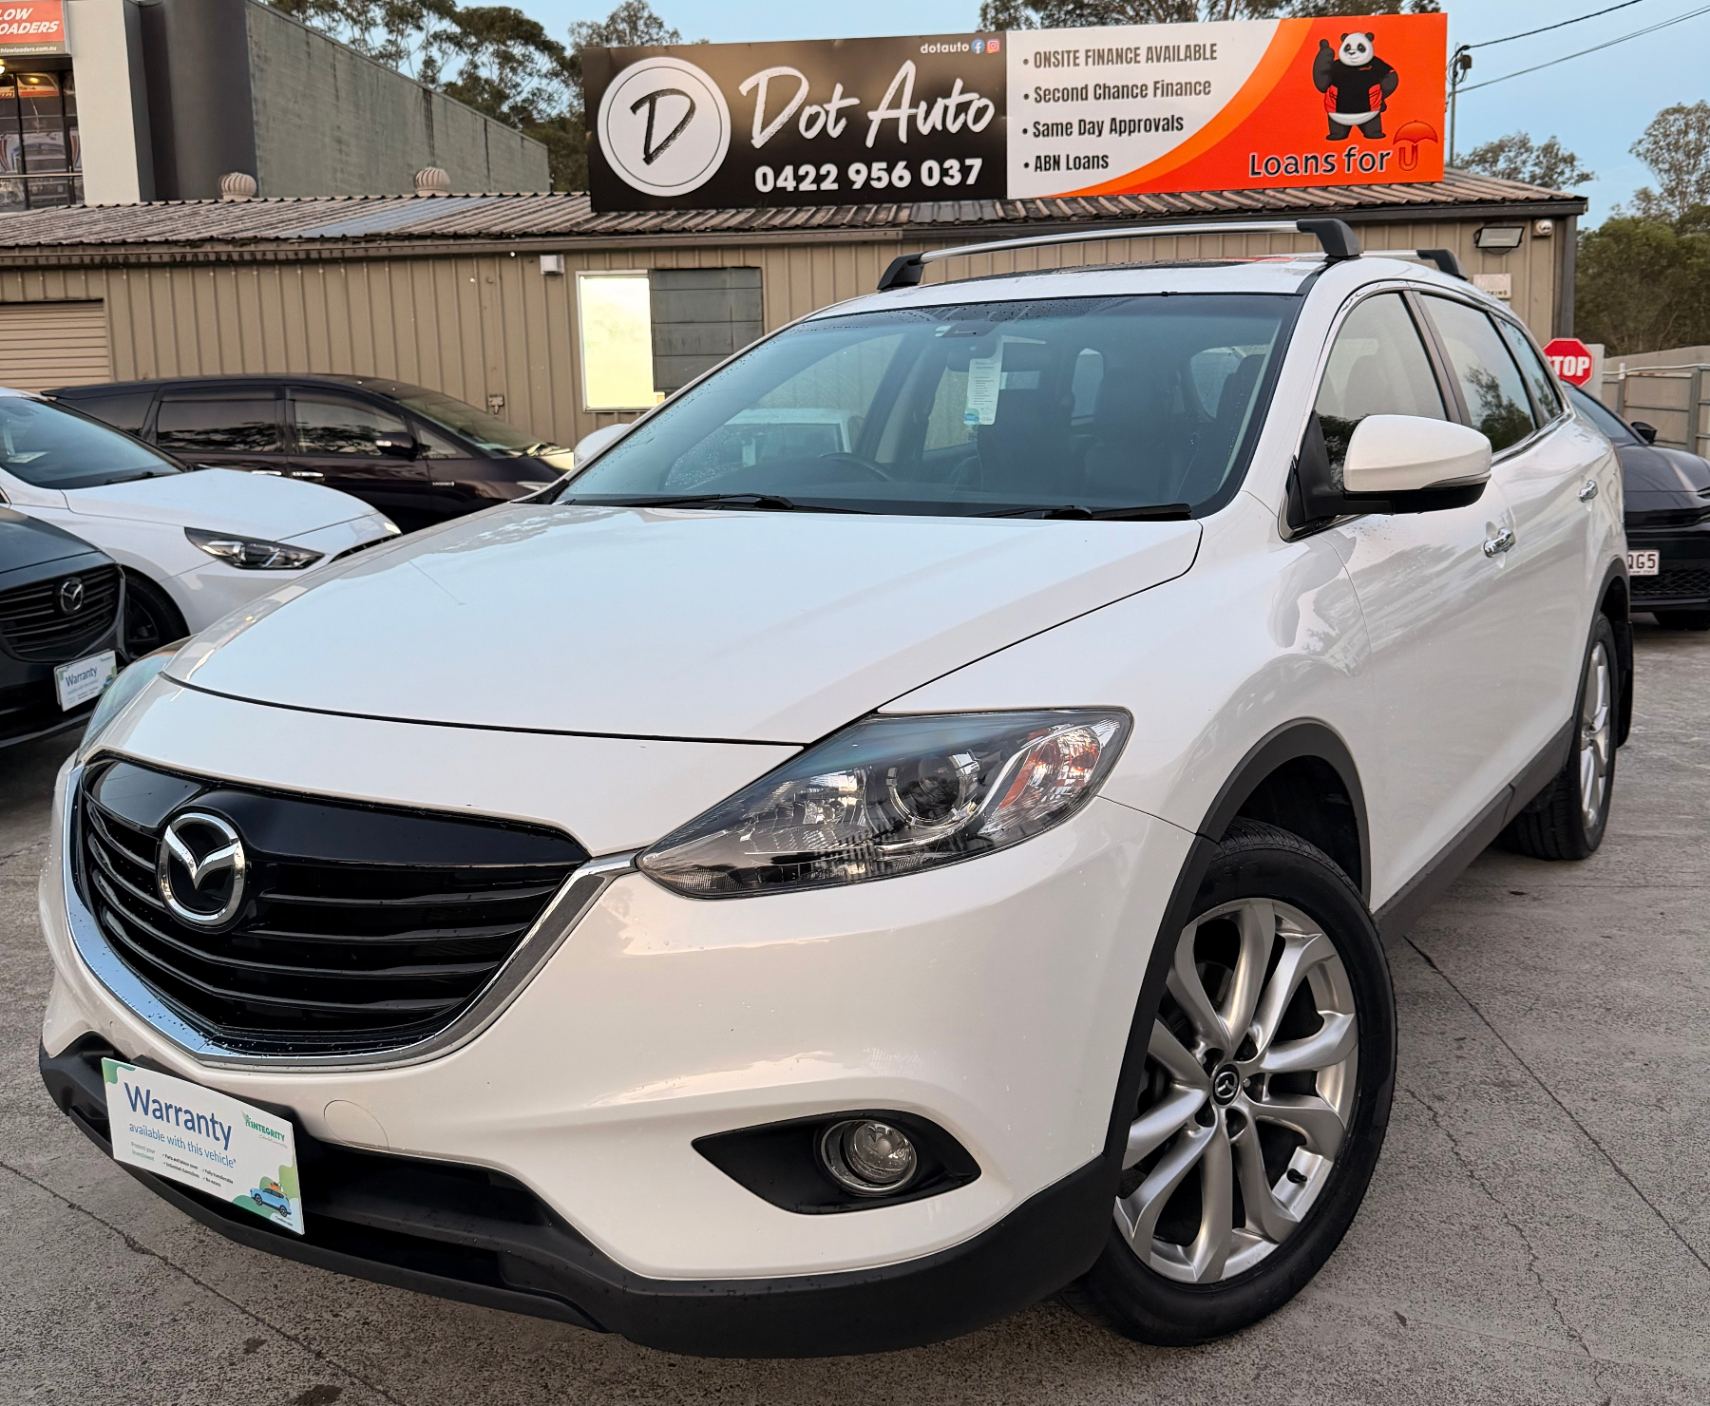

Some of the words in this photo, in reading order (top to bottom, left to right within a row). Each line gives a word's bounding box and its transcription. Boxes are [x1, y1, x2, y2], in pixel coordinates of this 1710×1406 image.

[920, 42, 969, 54] dotauto
[1034, 50, 1080, 69] ONSITE
[1085, 47, 1141, 66] FINANCE
[1146, 43, 1218, 63] AVAILABLE
[738, 66, 860, 149] Dot
[866, 60, 996, 148] Auto
[1034, 84, 1089, 104] Second
[1093, 82, 1148, 101] Chance
[1153, 80, 1211, 98] Finance
[630, 88, 696, 166] D
[1033, 120, 1073, 138] Same
[1078, 119, 1104, 138] Day
[1109, 115, 1184, 136] Approvals
[1034, 155, 1061, 172] ABN
[1066, 154, 1109, 172] Loans
[1249, 152, 1336, 177] Loans
[1344, 145, 1391, 173] for
[754, 163, 839, 193] 0422
[847, 161, 912, 190] 956
[920, 158, 983, 187] 037
[1547, 355, 1590, 376] TOP
[1628, 554, 1656, 570] QG5
[65, 667, 97, 687] Warranty
[124, 1082, 232, 1151] Warranty
[129, 1123, 165, 1142] available
[166, 1135, 186, 1150] with
[187, 1140, 202, 1156] this
